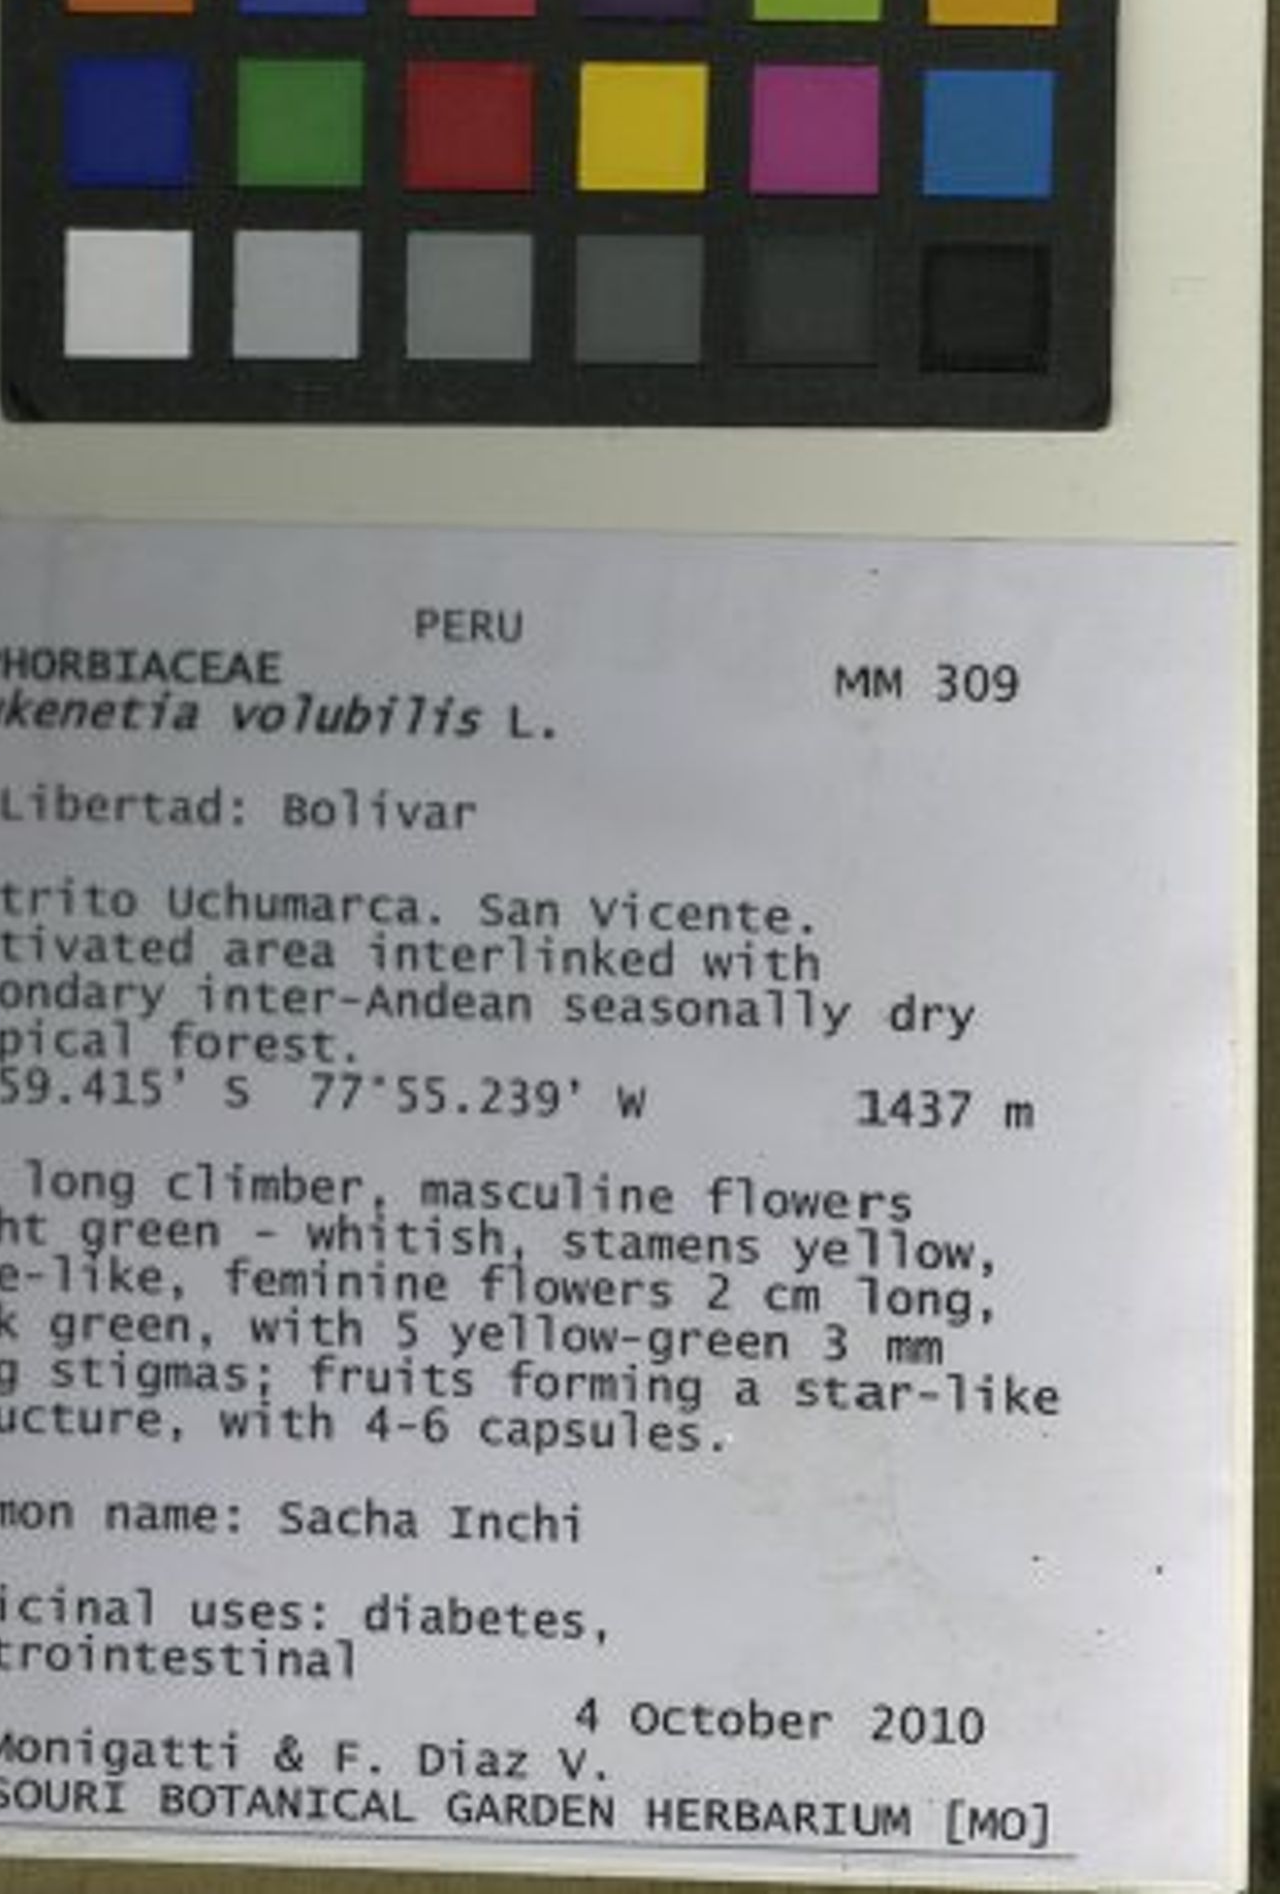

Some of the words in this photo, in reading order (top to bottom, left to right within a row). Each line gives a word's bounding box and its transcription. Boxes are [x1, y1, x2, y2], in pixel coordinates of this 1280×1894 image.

[415, 607, 523, 644] PERU
[835, 665, 903, 699] MM
[937, 663, 1020, 703] 309
[232, 691, 482, 738] volubilis
[509, 703, 557, 740] L.
[0, 781, 244, 827] Libertad:
[167, 879, 441, 926] Uchumarca.
[479, 892, 560, 929] San
[589, 890, 813, 936] Vicente.
[223, 937, 336, 969] area
[368, 930, 674, 978] interlinked
[702, 939, 820, 982] with
[196, 971, 532, 1022] inter-Andean
[564, 988, 852, 1038] seasonally
[888, 992, 976, 1042] dry
[169, 1019, 356, 1064] forest.
[224, 1074, 251, 1110] S
[616, 1085, 647, 1119] W
[857, 1088, 972, 1129] 1437
[1004, 1101, 1034, 1129] m
[24, 1157, 135, 1210] long
[166, 1161, 386, 1215] climber,
[420, 1171, 674, 1215] masculine
[707, 1175, 912, 1224] flowers
[80, 1217, 220, 1264] green
[305, 1208, 524, 1266] whitish,
[562, 1226, 760, 1265] stamens
[793, 1226, 994, 1279] yellow,
[224, 1255, 448, 1302] feminine
[479, 1259, 673, 1310] flowers
[707, 1272, 730, 1311] 2
[763, 1282, 821, 1313] cm
[856, 1274, 993, 1329] long,
[49, 1311, 212, 1352] green,
[249, 1305, 363, 1347] with
[397, 1310, 419, 1351] 5
[449, 1311, 789, 1366] yellow-green
[824, 1322, 848, 1362] 3
[886, 1334, 944, 1366] mm
[50, 1350, 270, 1403] stigmas;
[309, 1352, 474, 1398] fruits
[508, 1358, 702, 1414] forming
[735, 1377, 761, 1407] a
[795, 1372, 1060, 1416] star-like
[219, 1394, 334, 1441] with
[365, 1404, 450, 1444] 4-6
[478, 1409, 723, 1456] capsules.
[105, 1501, 240, 1534] name:
[278, 1496, 419, 1539] Sacha
[449, 1501, 580, 1543] Inchi
[190, 1598, 325, 1631] uses:
[363, 1592, 606, 1646] diabetes,
[575, 1697, 599, 1734] 4
[630, 1697, 833, 1741] October
[871, 1703, 985, 1745] 2010
[273, 1733, 304, 1773] &
[335, 1739, 381, 1775] F.
[418, 1737, 528, 1780] Diaz
[557, 1747, 606, 1782] V.
[159, 1783, 417, 1823] BOTANICAL
[446, 1789, 615, 1829] GARDEN
[646, 1797, 911, 1837] HERBARIUM
[946, 1798, 1049, 1850] [MO]
